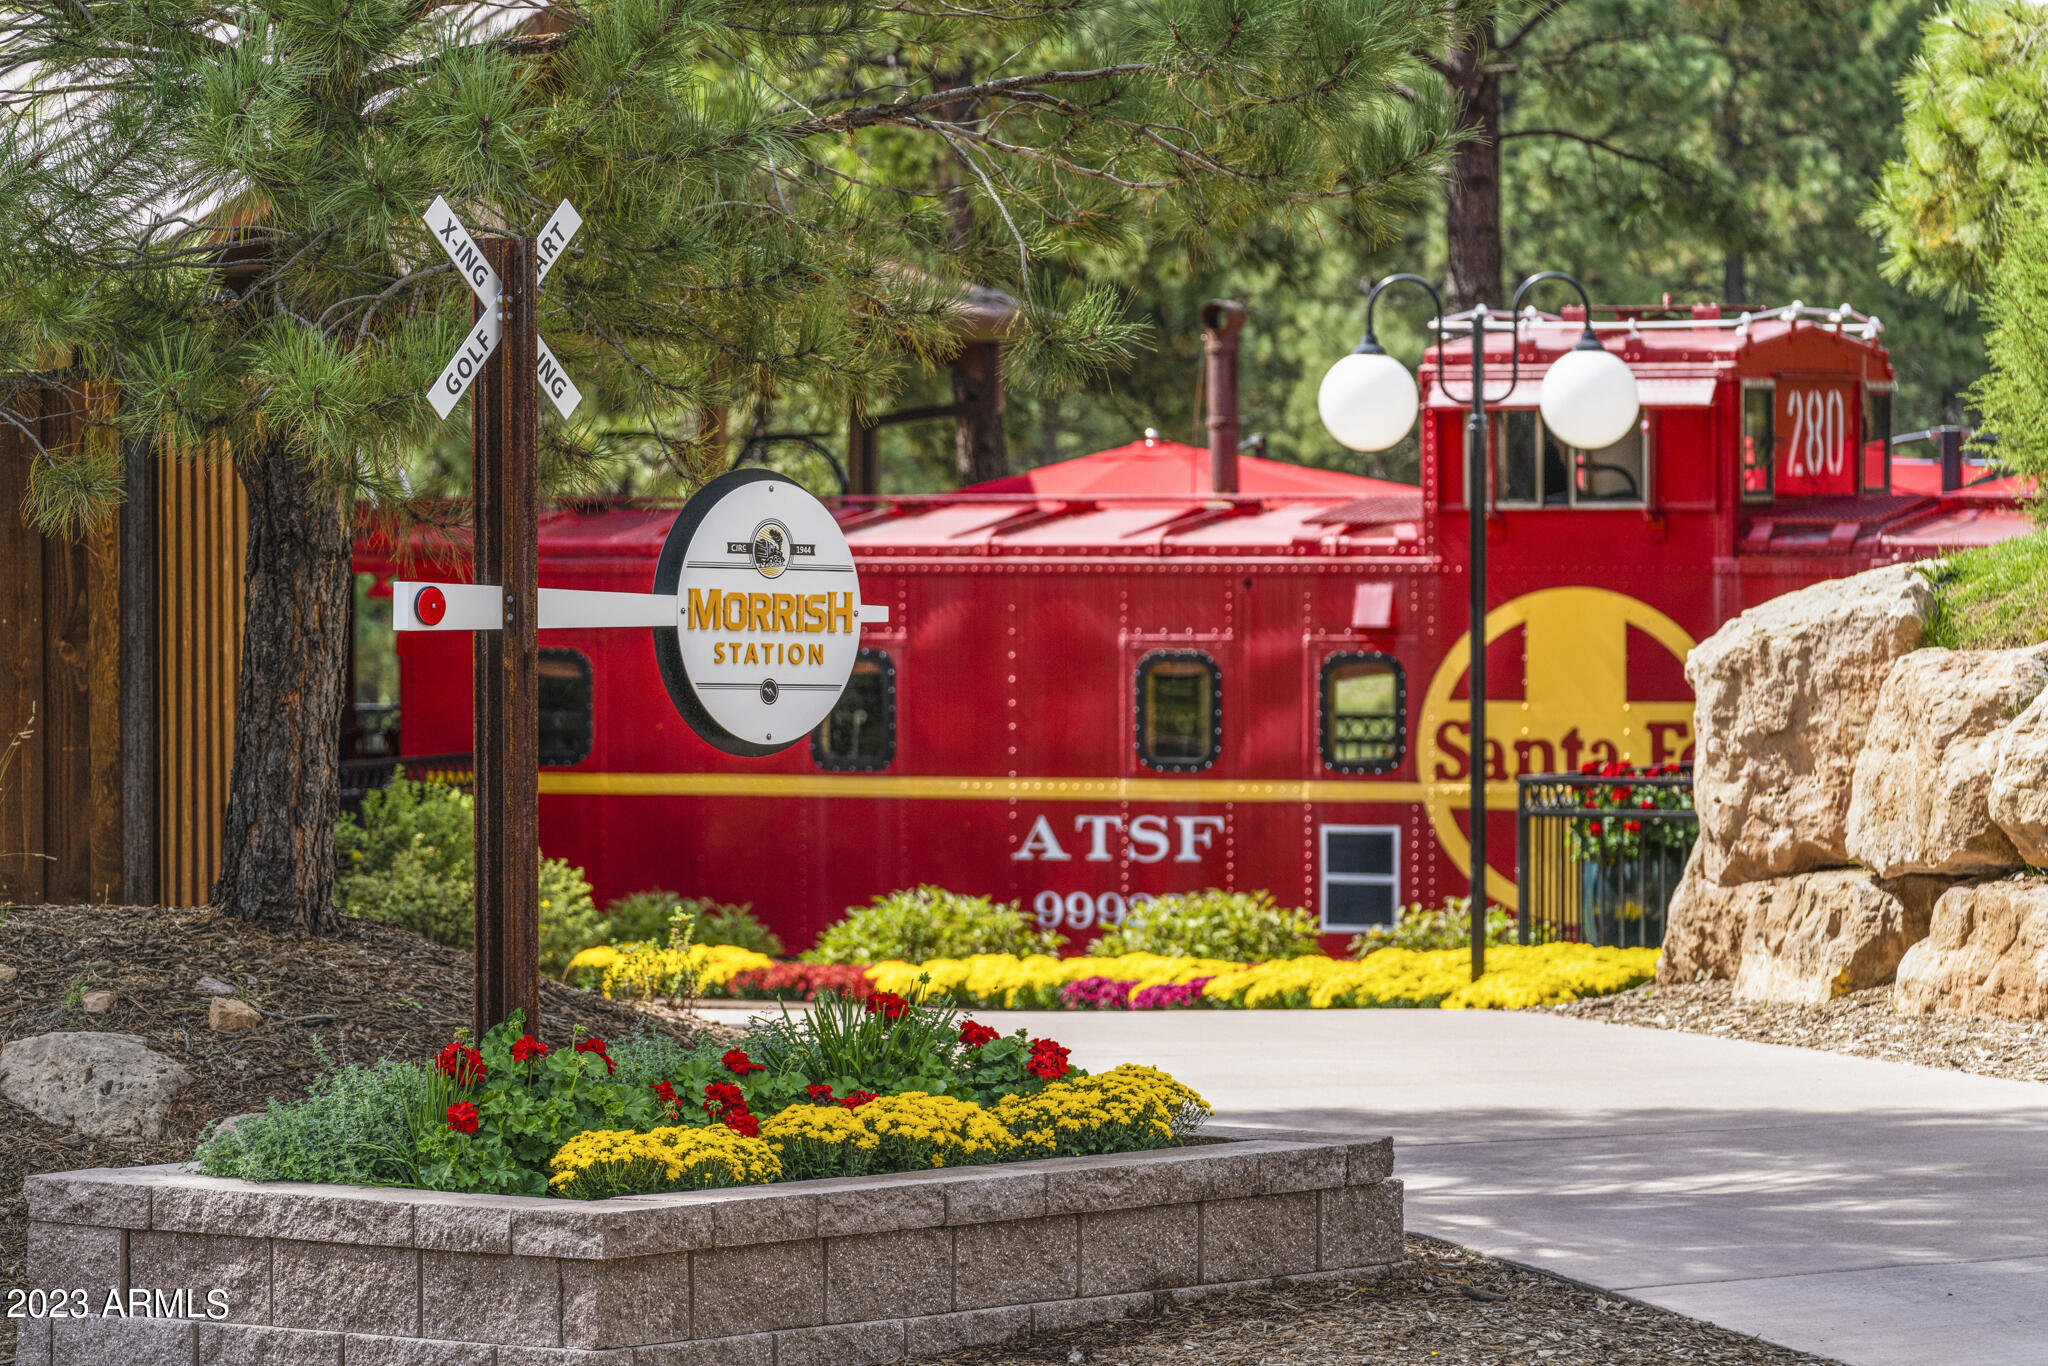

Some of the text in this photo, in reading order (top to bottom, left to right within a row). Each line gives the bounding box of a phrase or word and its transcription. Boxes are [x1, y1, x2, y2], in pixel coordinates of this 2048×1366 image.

[439, 218, 567, 399] X-ING ING
[445, 221, 565, 395] GOLF ART
[1787, 389, 1844, 477] 280
[796, 545, 811, 554] 1944
[687, 588, 853, 633] MORRISH
[714, 642, 824, 665] STATION
[1645, 721, 1696, 764] F
[1010, 814, 1225, 863] ATSF
